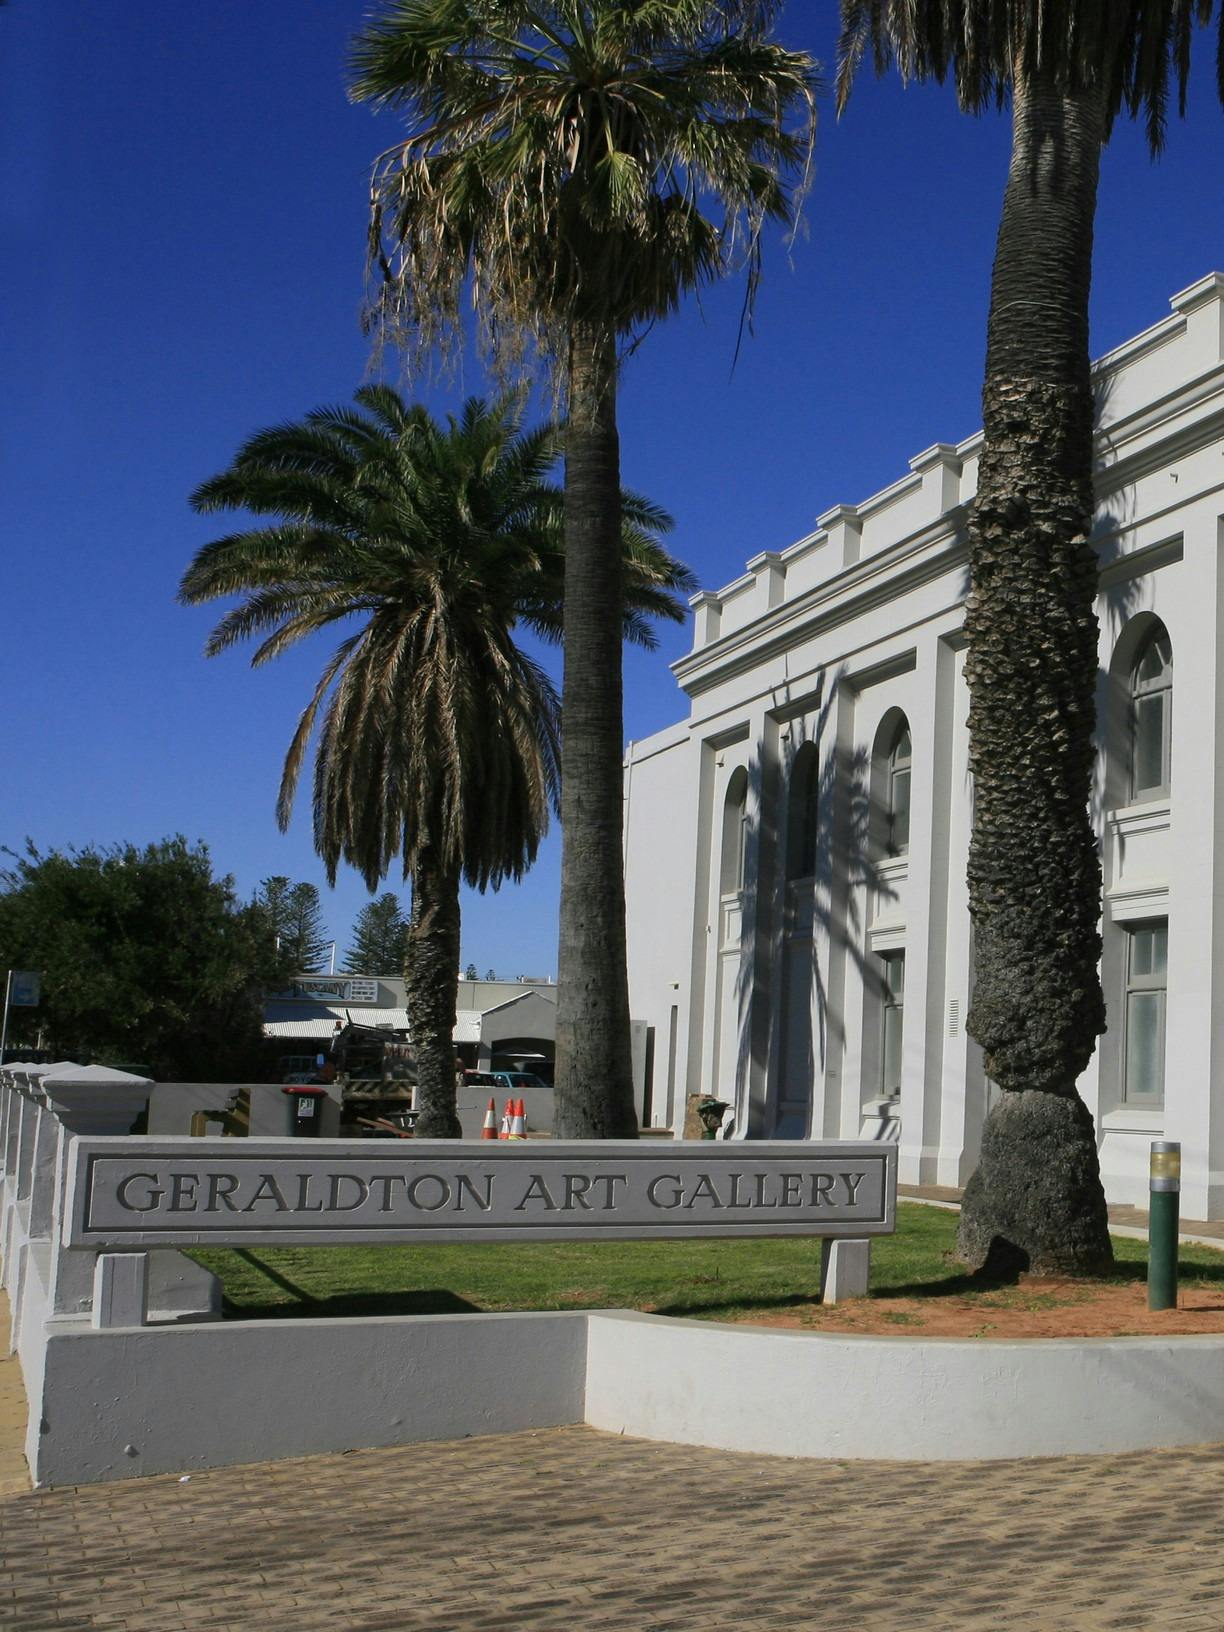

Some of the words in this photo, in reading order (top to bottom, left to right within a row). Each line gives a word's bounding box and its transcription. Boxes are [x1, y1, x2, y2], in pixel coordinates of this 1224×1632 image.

[116, 1172, 496, 1213] GERALDTON
[514, 1173, 629, 1212] ART
[647, 1172, 867, 1211] GALLERY
